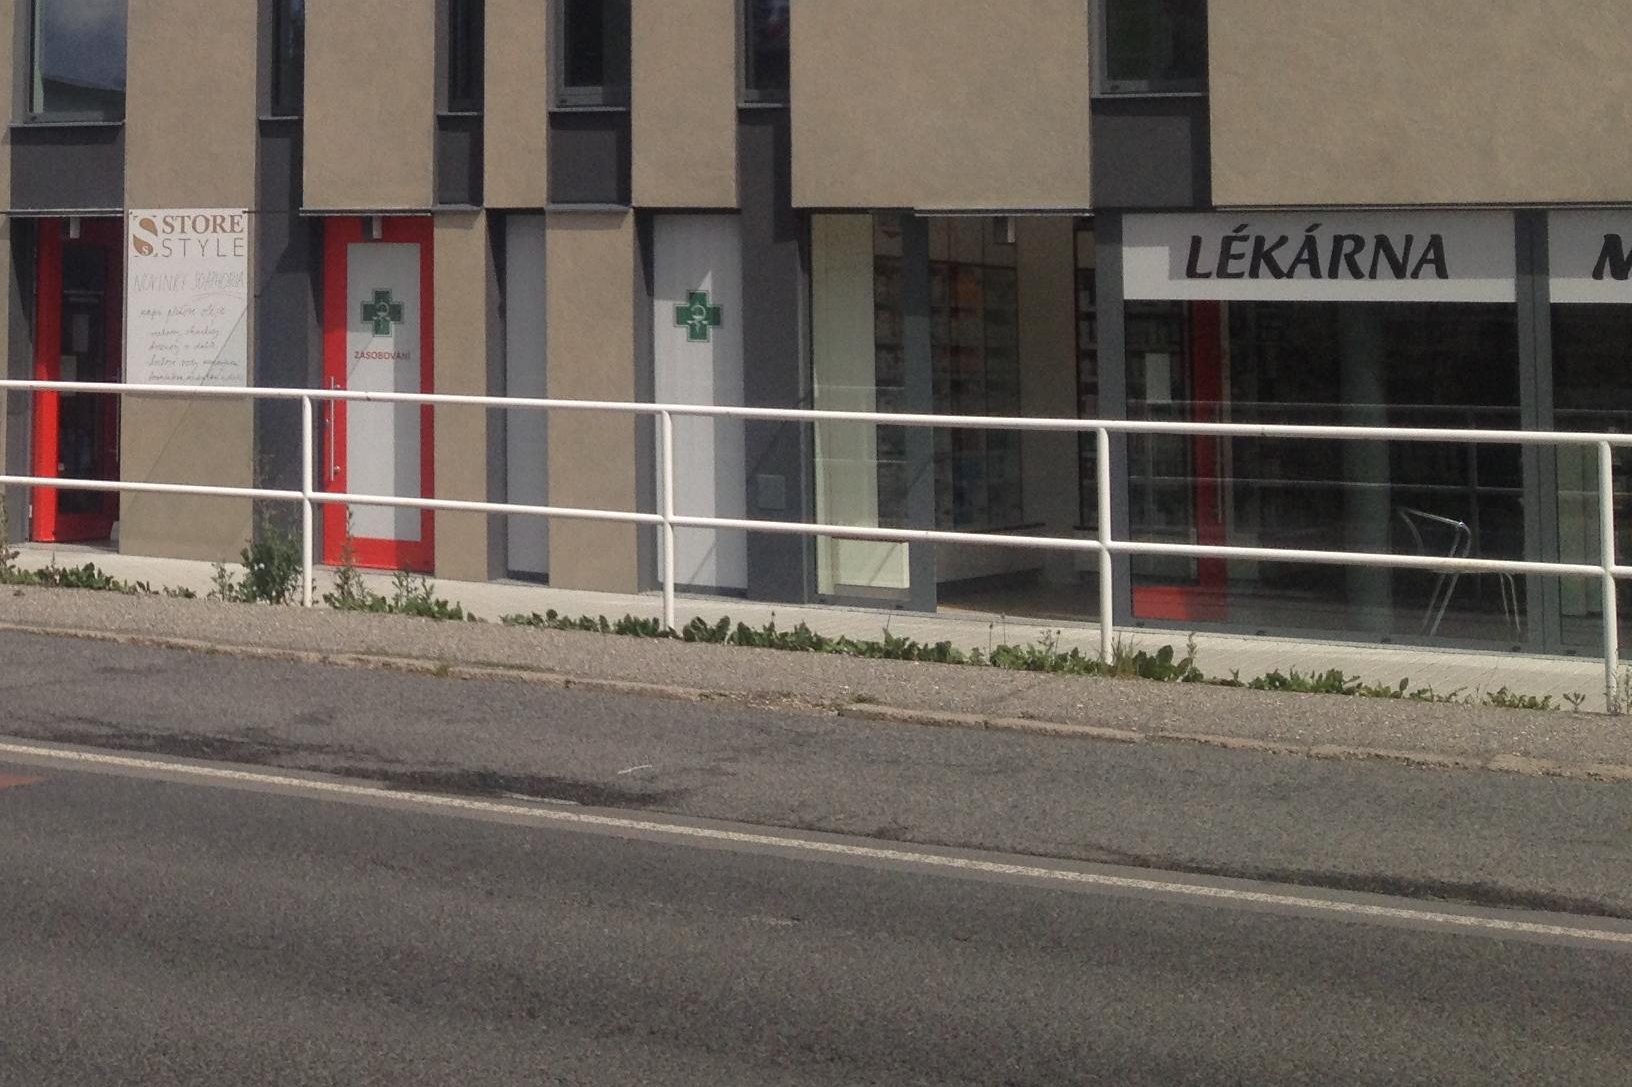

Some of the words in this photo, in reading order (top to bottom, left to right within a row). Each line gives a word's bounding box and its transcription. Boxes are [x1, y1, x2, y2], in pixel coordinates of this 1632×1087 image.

[162, 214, 244, 234] STORE
[162, 238, 244, 257] STYLE
[1185, 222, 1450, 280] LÉKÁRNA
